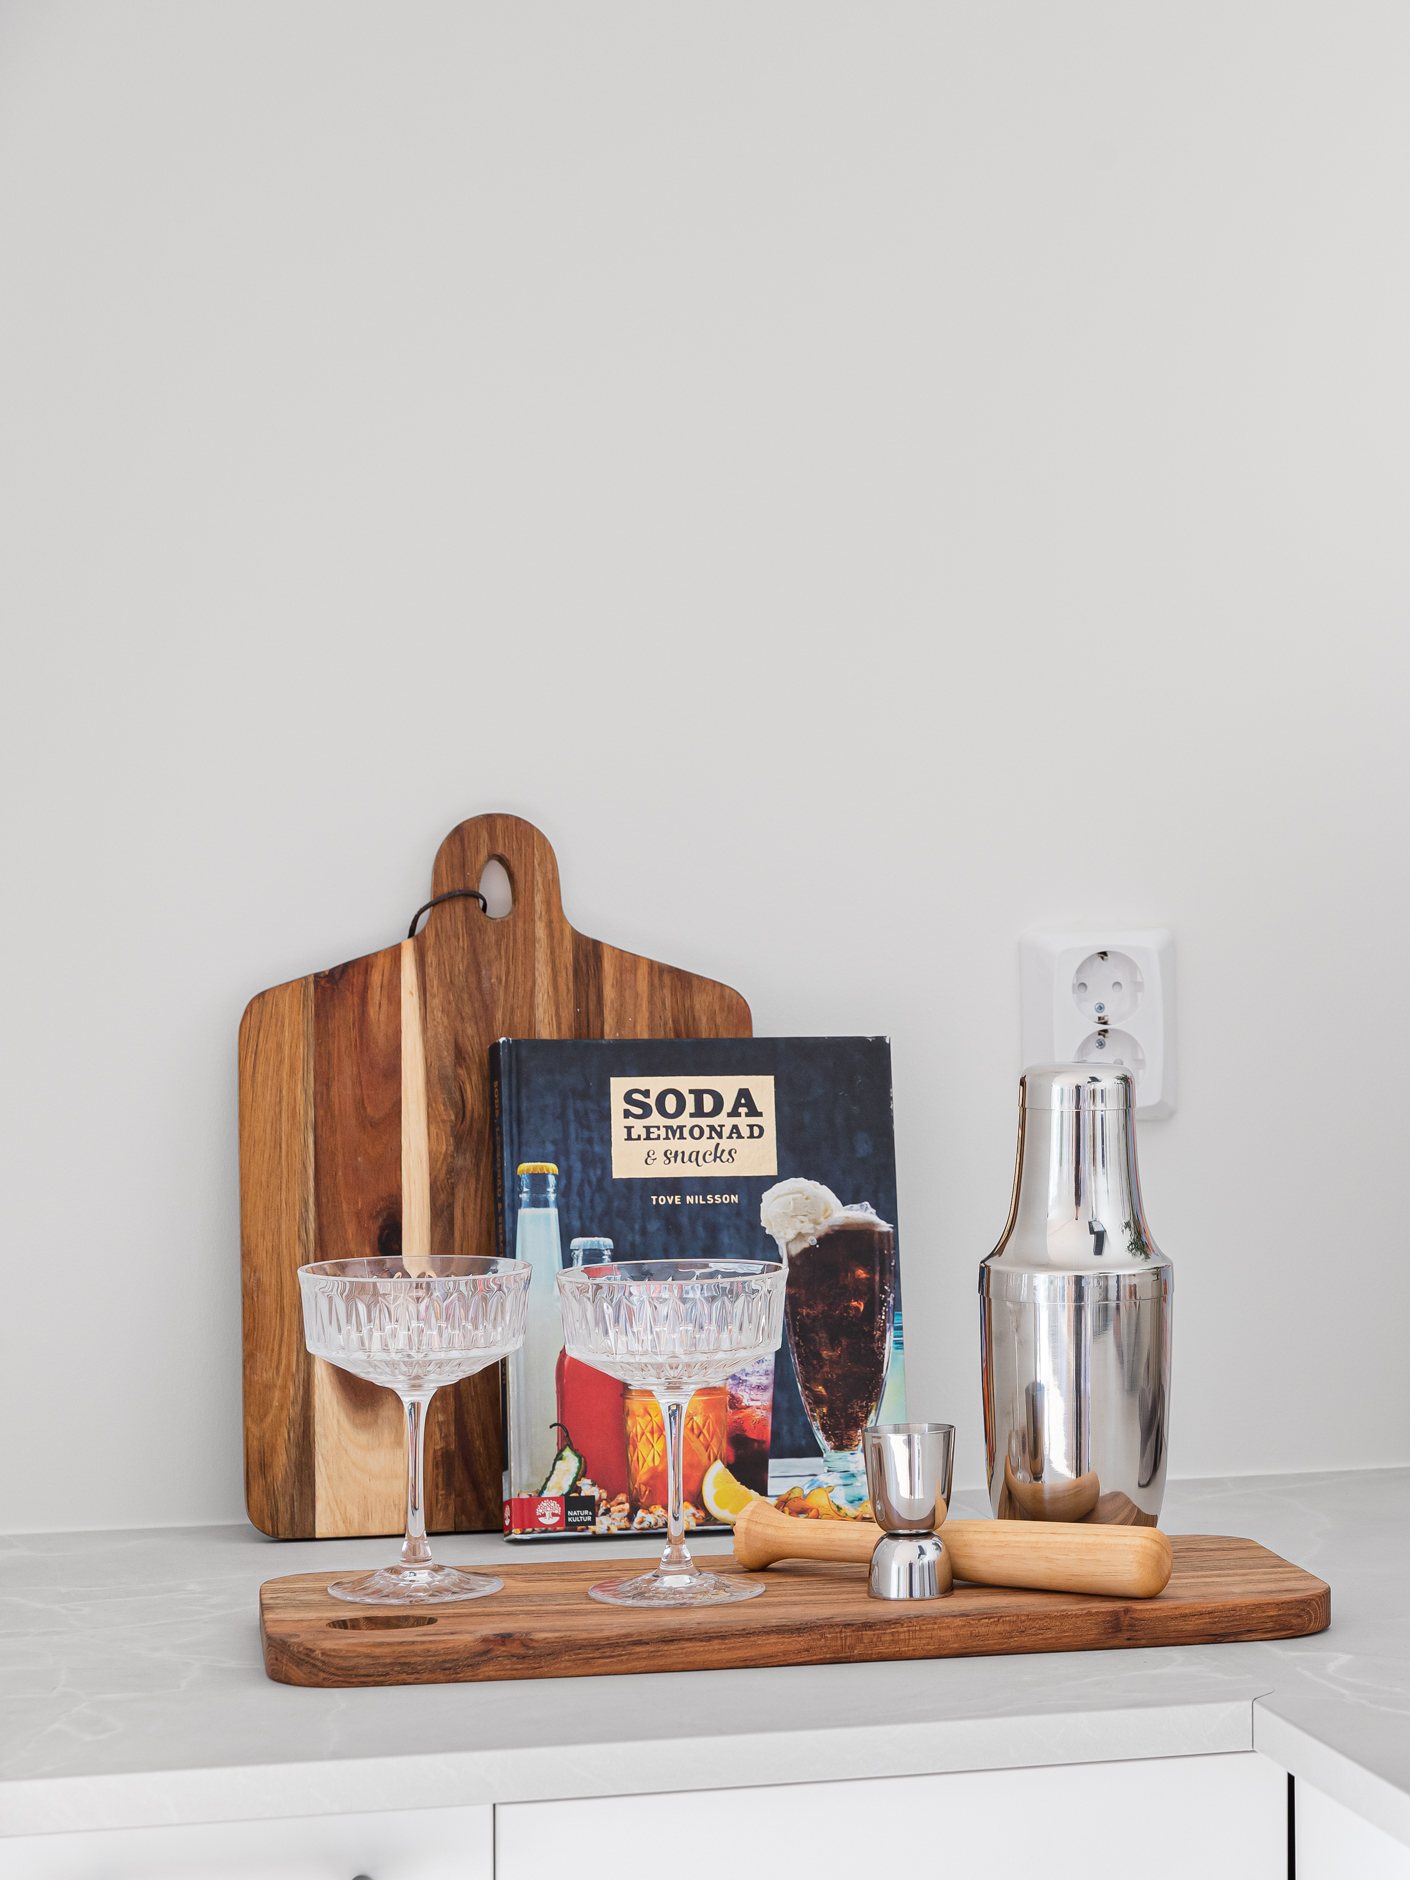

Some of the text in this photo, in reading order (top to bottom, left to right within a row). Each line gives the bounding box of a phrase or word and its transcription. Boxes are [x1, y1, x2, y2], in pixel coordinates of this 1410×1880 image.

[623, 1088, 764, 1120] SODA
[623, 1124, 765, 1141] LEMONAD
[644, 1142, 737, 1167] & snacks
[651, 1194, 739, 1205] TOVE NILSSON
